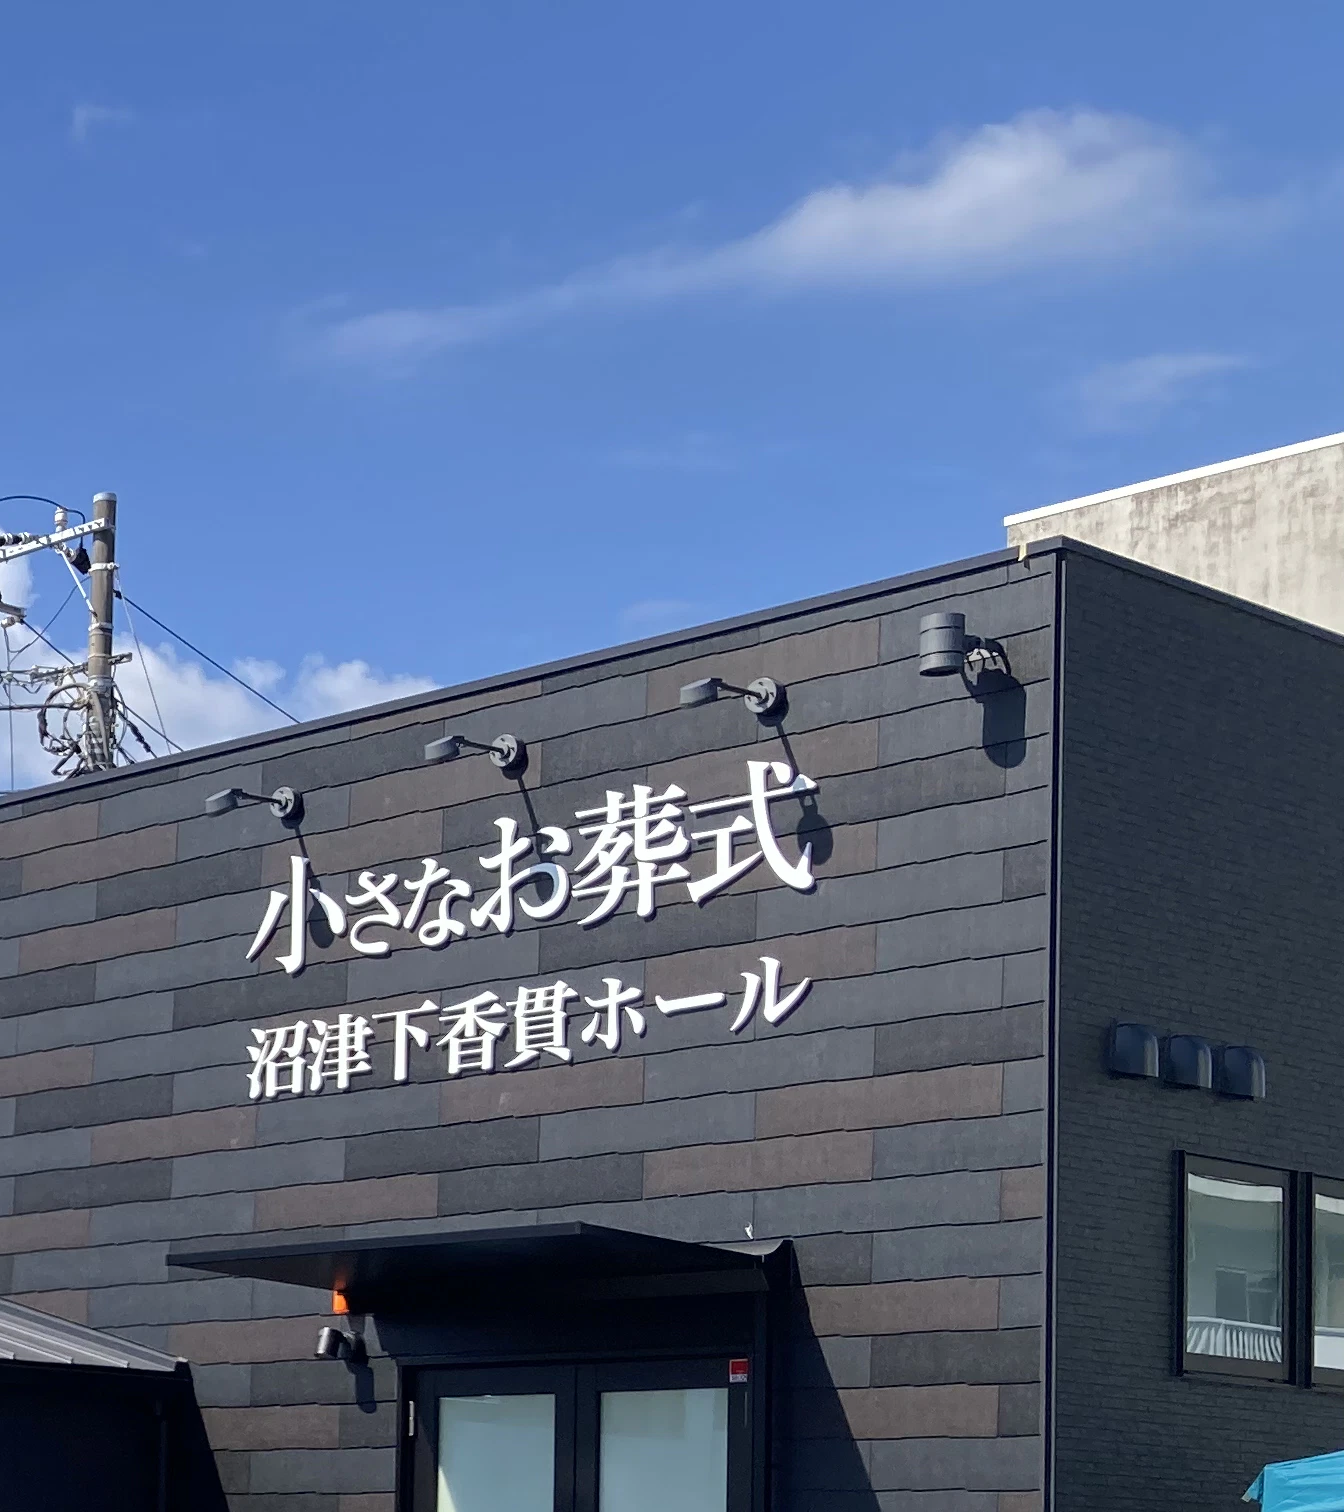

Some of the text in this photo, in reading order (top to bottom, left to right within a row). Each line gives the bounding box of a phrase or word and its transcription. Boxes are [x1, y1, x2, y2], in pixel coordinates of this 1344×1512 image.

[245, 760, 818, 974] 小さなお葬式
[244, 956, 813, 1100] 沼津下香貫ホール
